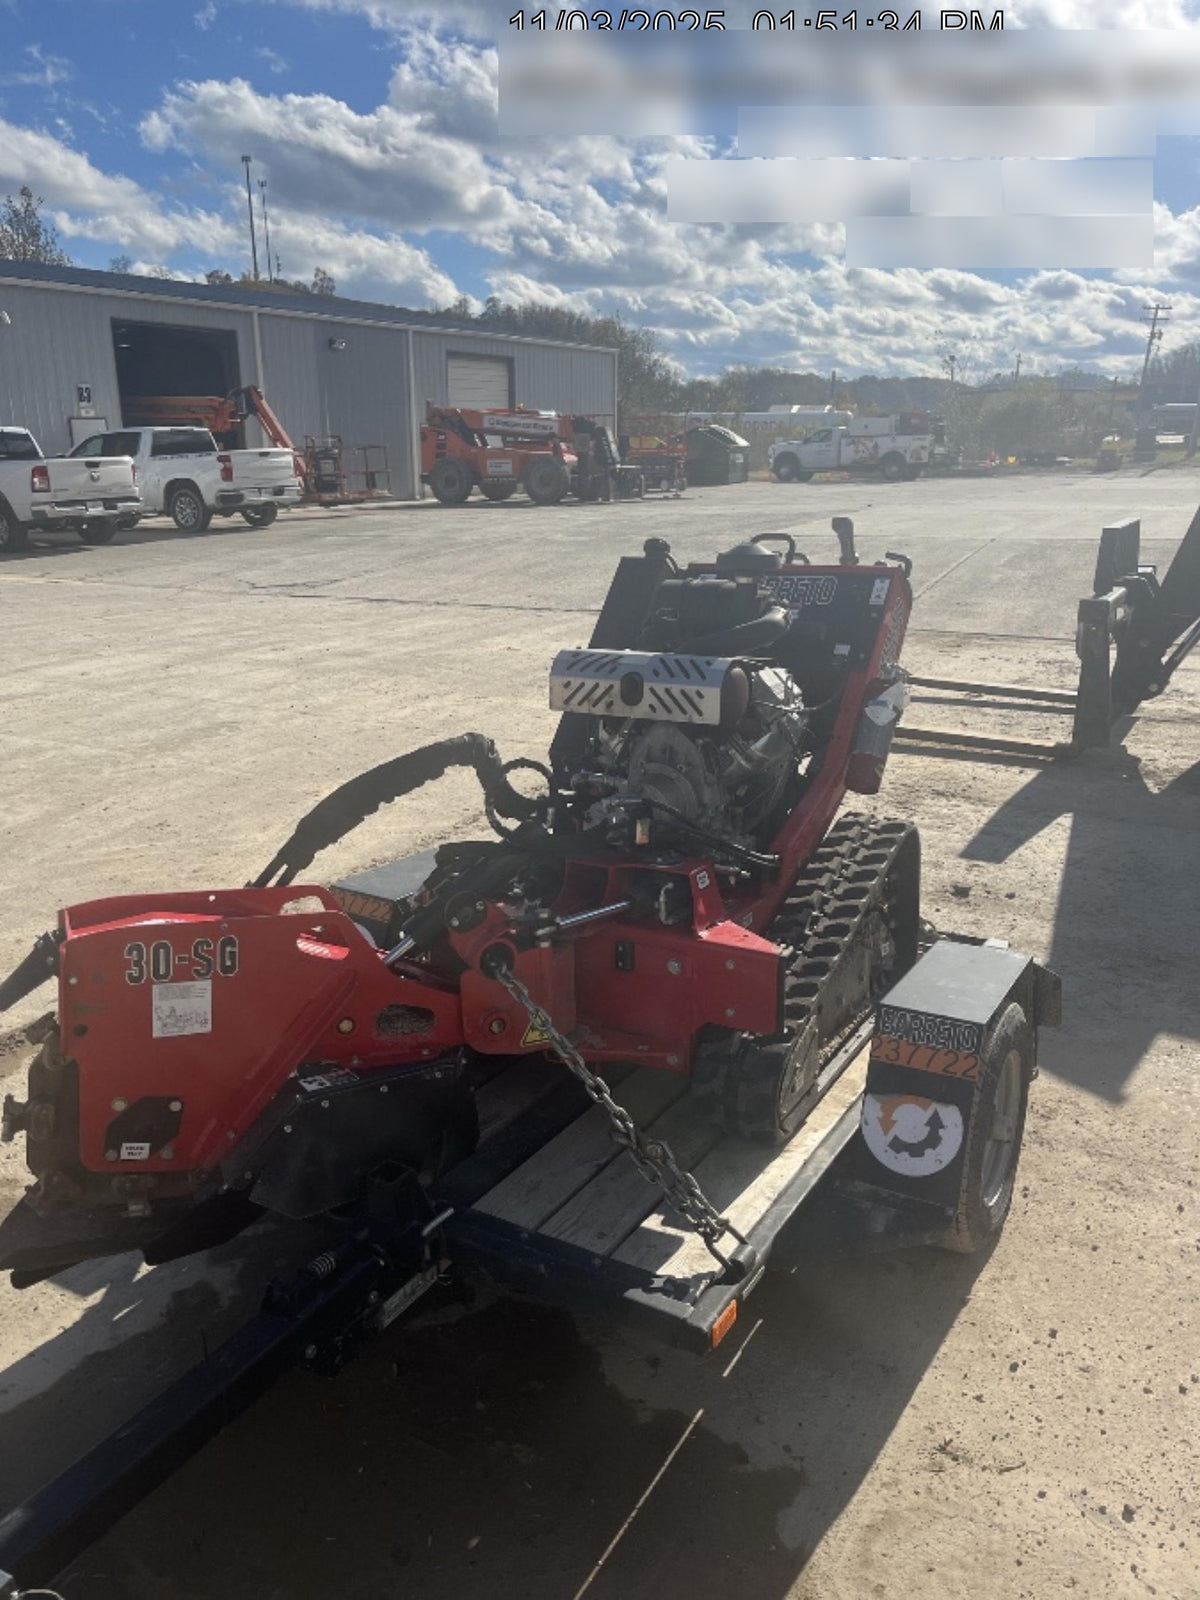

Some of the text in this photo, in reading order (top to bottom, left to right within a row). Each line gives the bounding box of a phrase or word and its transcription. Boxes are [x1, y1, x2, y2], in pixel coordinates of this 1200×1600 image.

[124, 935, 239, 986] 30-SG
[880, 1007, 978, 1054] BARRETO
[869, 1035, 979, 1080] 237722
